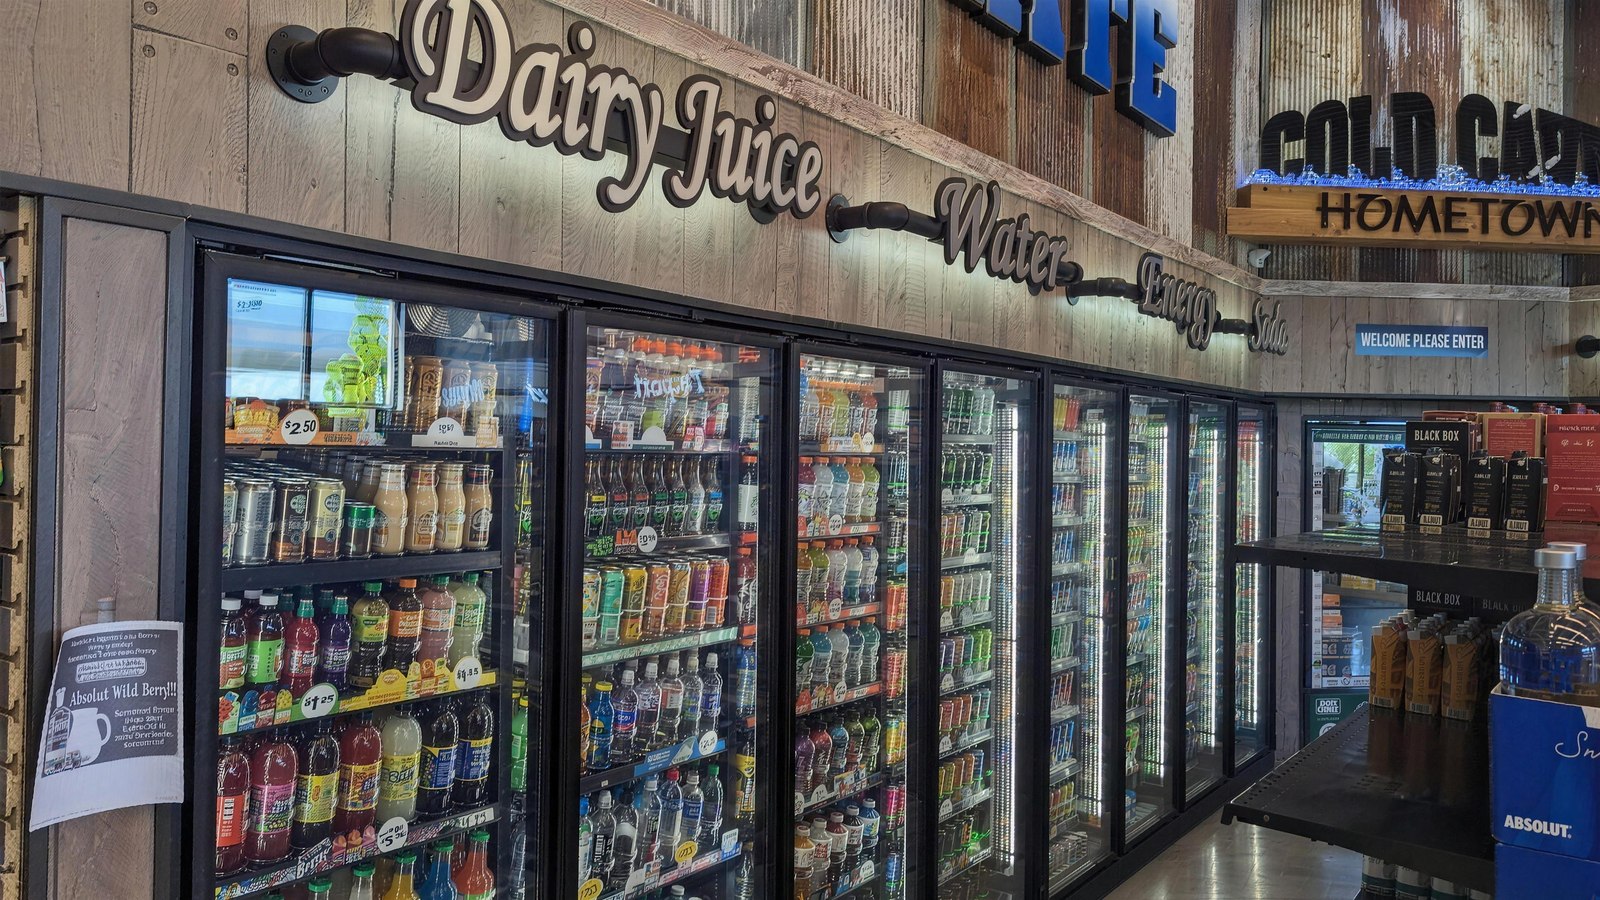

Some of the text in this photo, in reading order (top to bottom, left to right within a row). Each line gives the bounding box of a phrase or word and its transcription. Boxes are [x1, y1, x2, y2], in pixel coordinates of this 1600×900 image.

[403, 0, 823, 217] Dairy Juice
[1260, 92, 1437, 182] COLD
[935, 177, 1068, 292] Water
[1138, 252, 1217, 350] Energy
[1249, 298, 1288, 354] Soda
[1361, 332, 1484, 349] WELCOME PLEASE ENTER
[285, 419, 317, 435] $2.50
[1414, 429, 1441, 441] BLACK
[1442, 430, 1460, 442] BOX
[1416, 590, 1461, 606] BLACK BOX
[69, 687, 110, 707] Absolut
[112, 682, 139, 700] Wild
